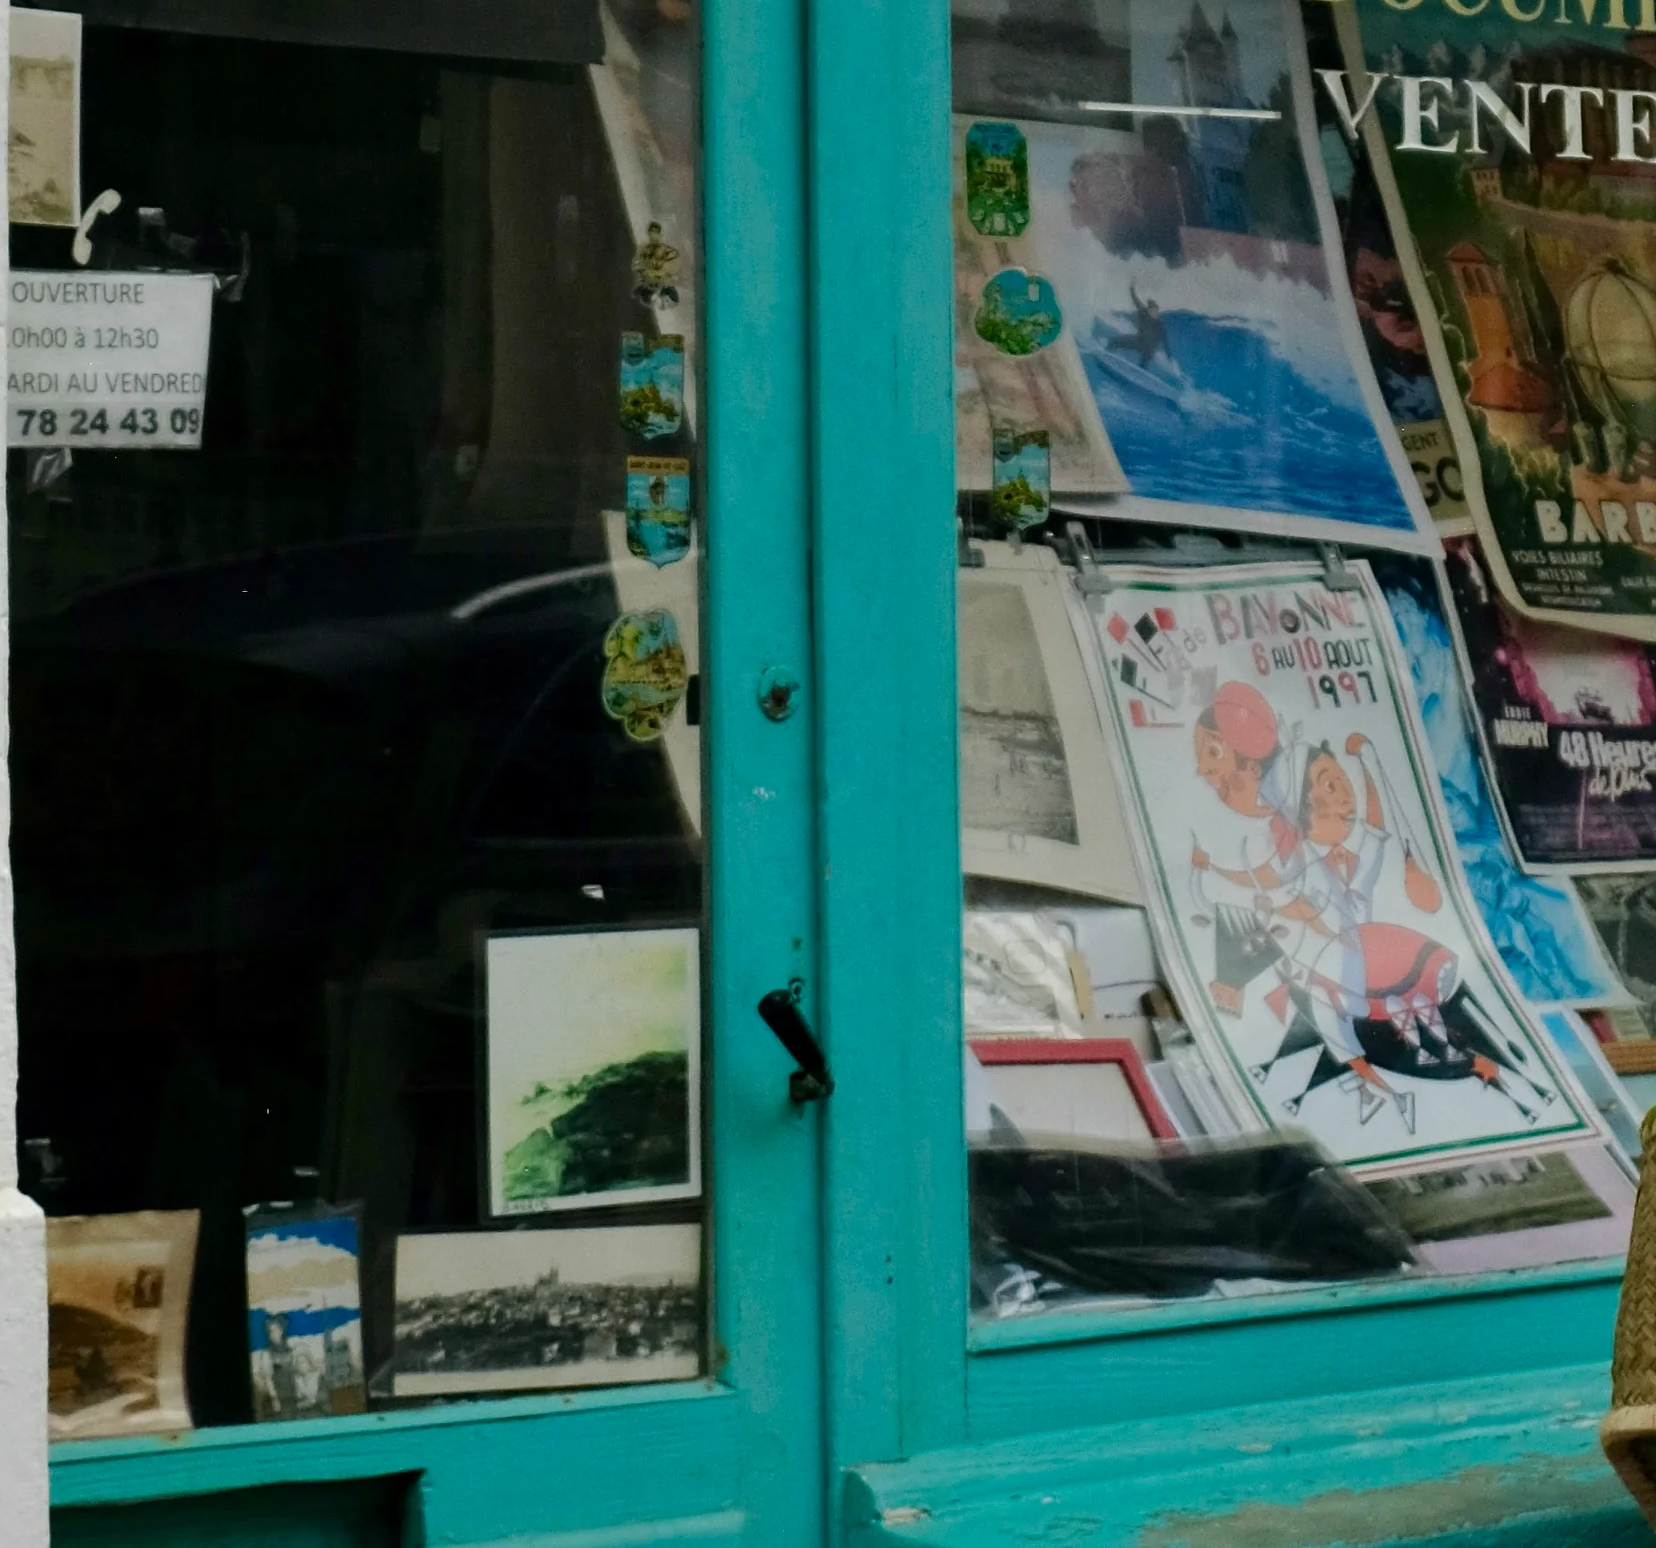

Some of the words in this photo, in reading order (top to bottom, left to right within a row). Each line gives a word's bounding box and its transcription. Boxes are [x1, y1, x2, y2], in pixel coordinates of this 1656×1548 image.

[11, 281, 145, 305] OUVERTURE
[8, 327, 68, 349] 0h00
[95, 327, 160, 349] 12h30
[8, 372, 59, 393] ARDI
[67, 372, 98, 393] AU
[17, 408, 58, 436] 78
[69, 408, 110, 436] 24
[120, 408, 159, 436] 43
[170, 408, 200, 435] 09
[1252, 641, 1271, 677] 6
[1293, 636, 1322, 672] 10
[1307, 670, 1378, 710] 1997
[1559, 730, 1590, 768] 48
